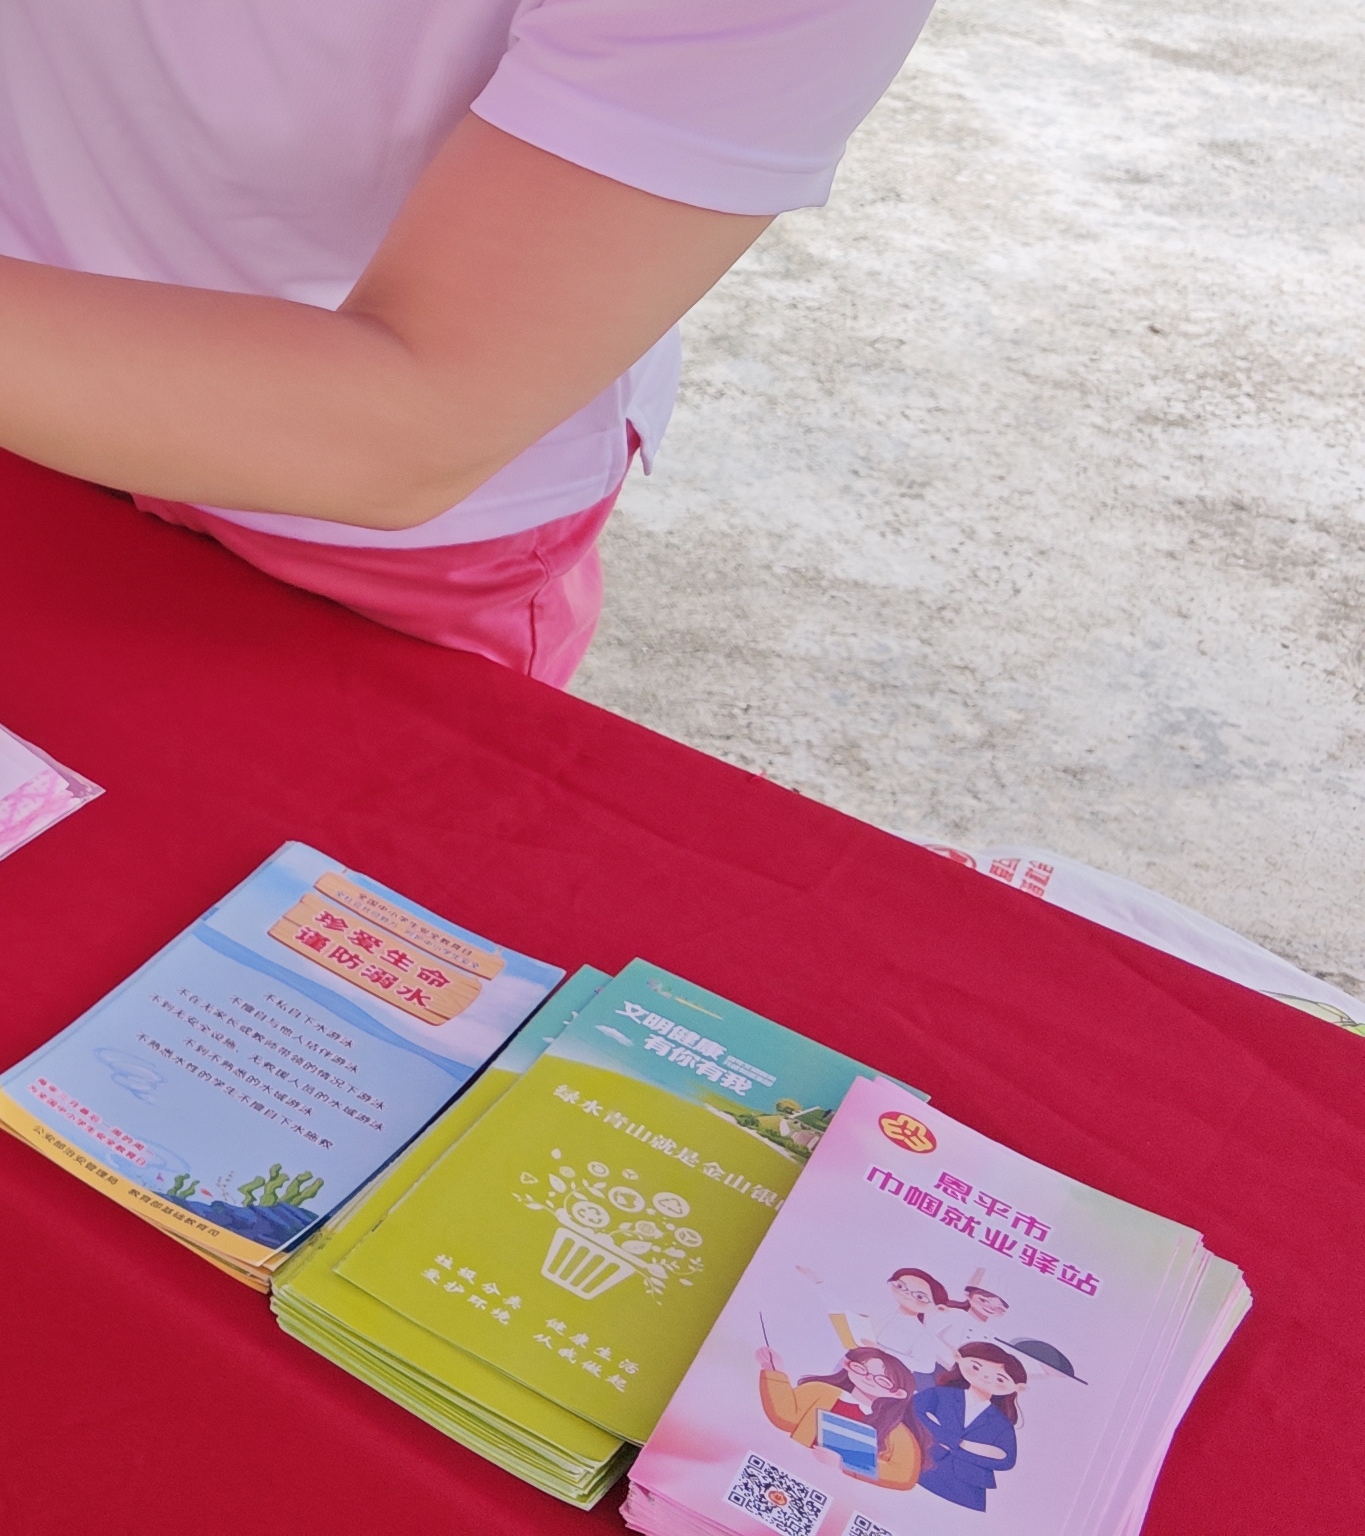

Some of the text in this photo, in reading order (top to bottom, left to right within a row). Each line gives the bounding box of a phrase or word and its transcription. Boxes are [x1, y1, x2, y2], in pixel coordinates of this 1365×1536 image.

[295, 925, 432, 1010] 谨防溺水
[315, 910, 451, 989] 珍爱生命
[229, 994, 359, 1074] 不擅自与他人结伴游泳
[263, 991, 355, 1049] 不私自下水游泳
[615, 1000, 727, 1062] 文明健康
[183, 1036, 314, 1117] 不到不熟悉的水域游泳
[643, 1033, 753, 1096] 有你有我
[553, 1084, 785, 1213] 绿水青山就是金山银
[866, 1166, 1100, 1297] 巾帼就业驿站
[933, 1171, 1052, 1243] 恩平市
[532, 1332, 628, 1393] 从我做起
[545, 1317, 640, 1375] 健康生活
